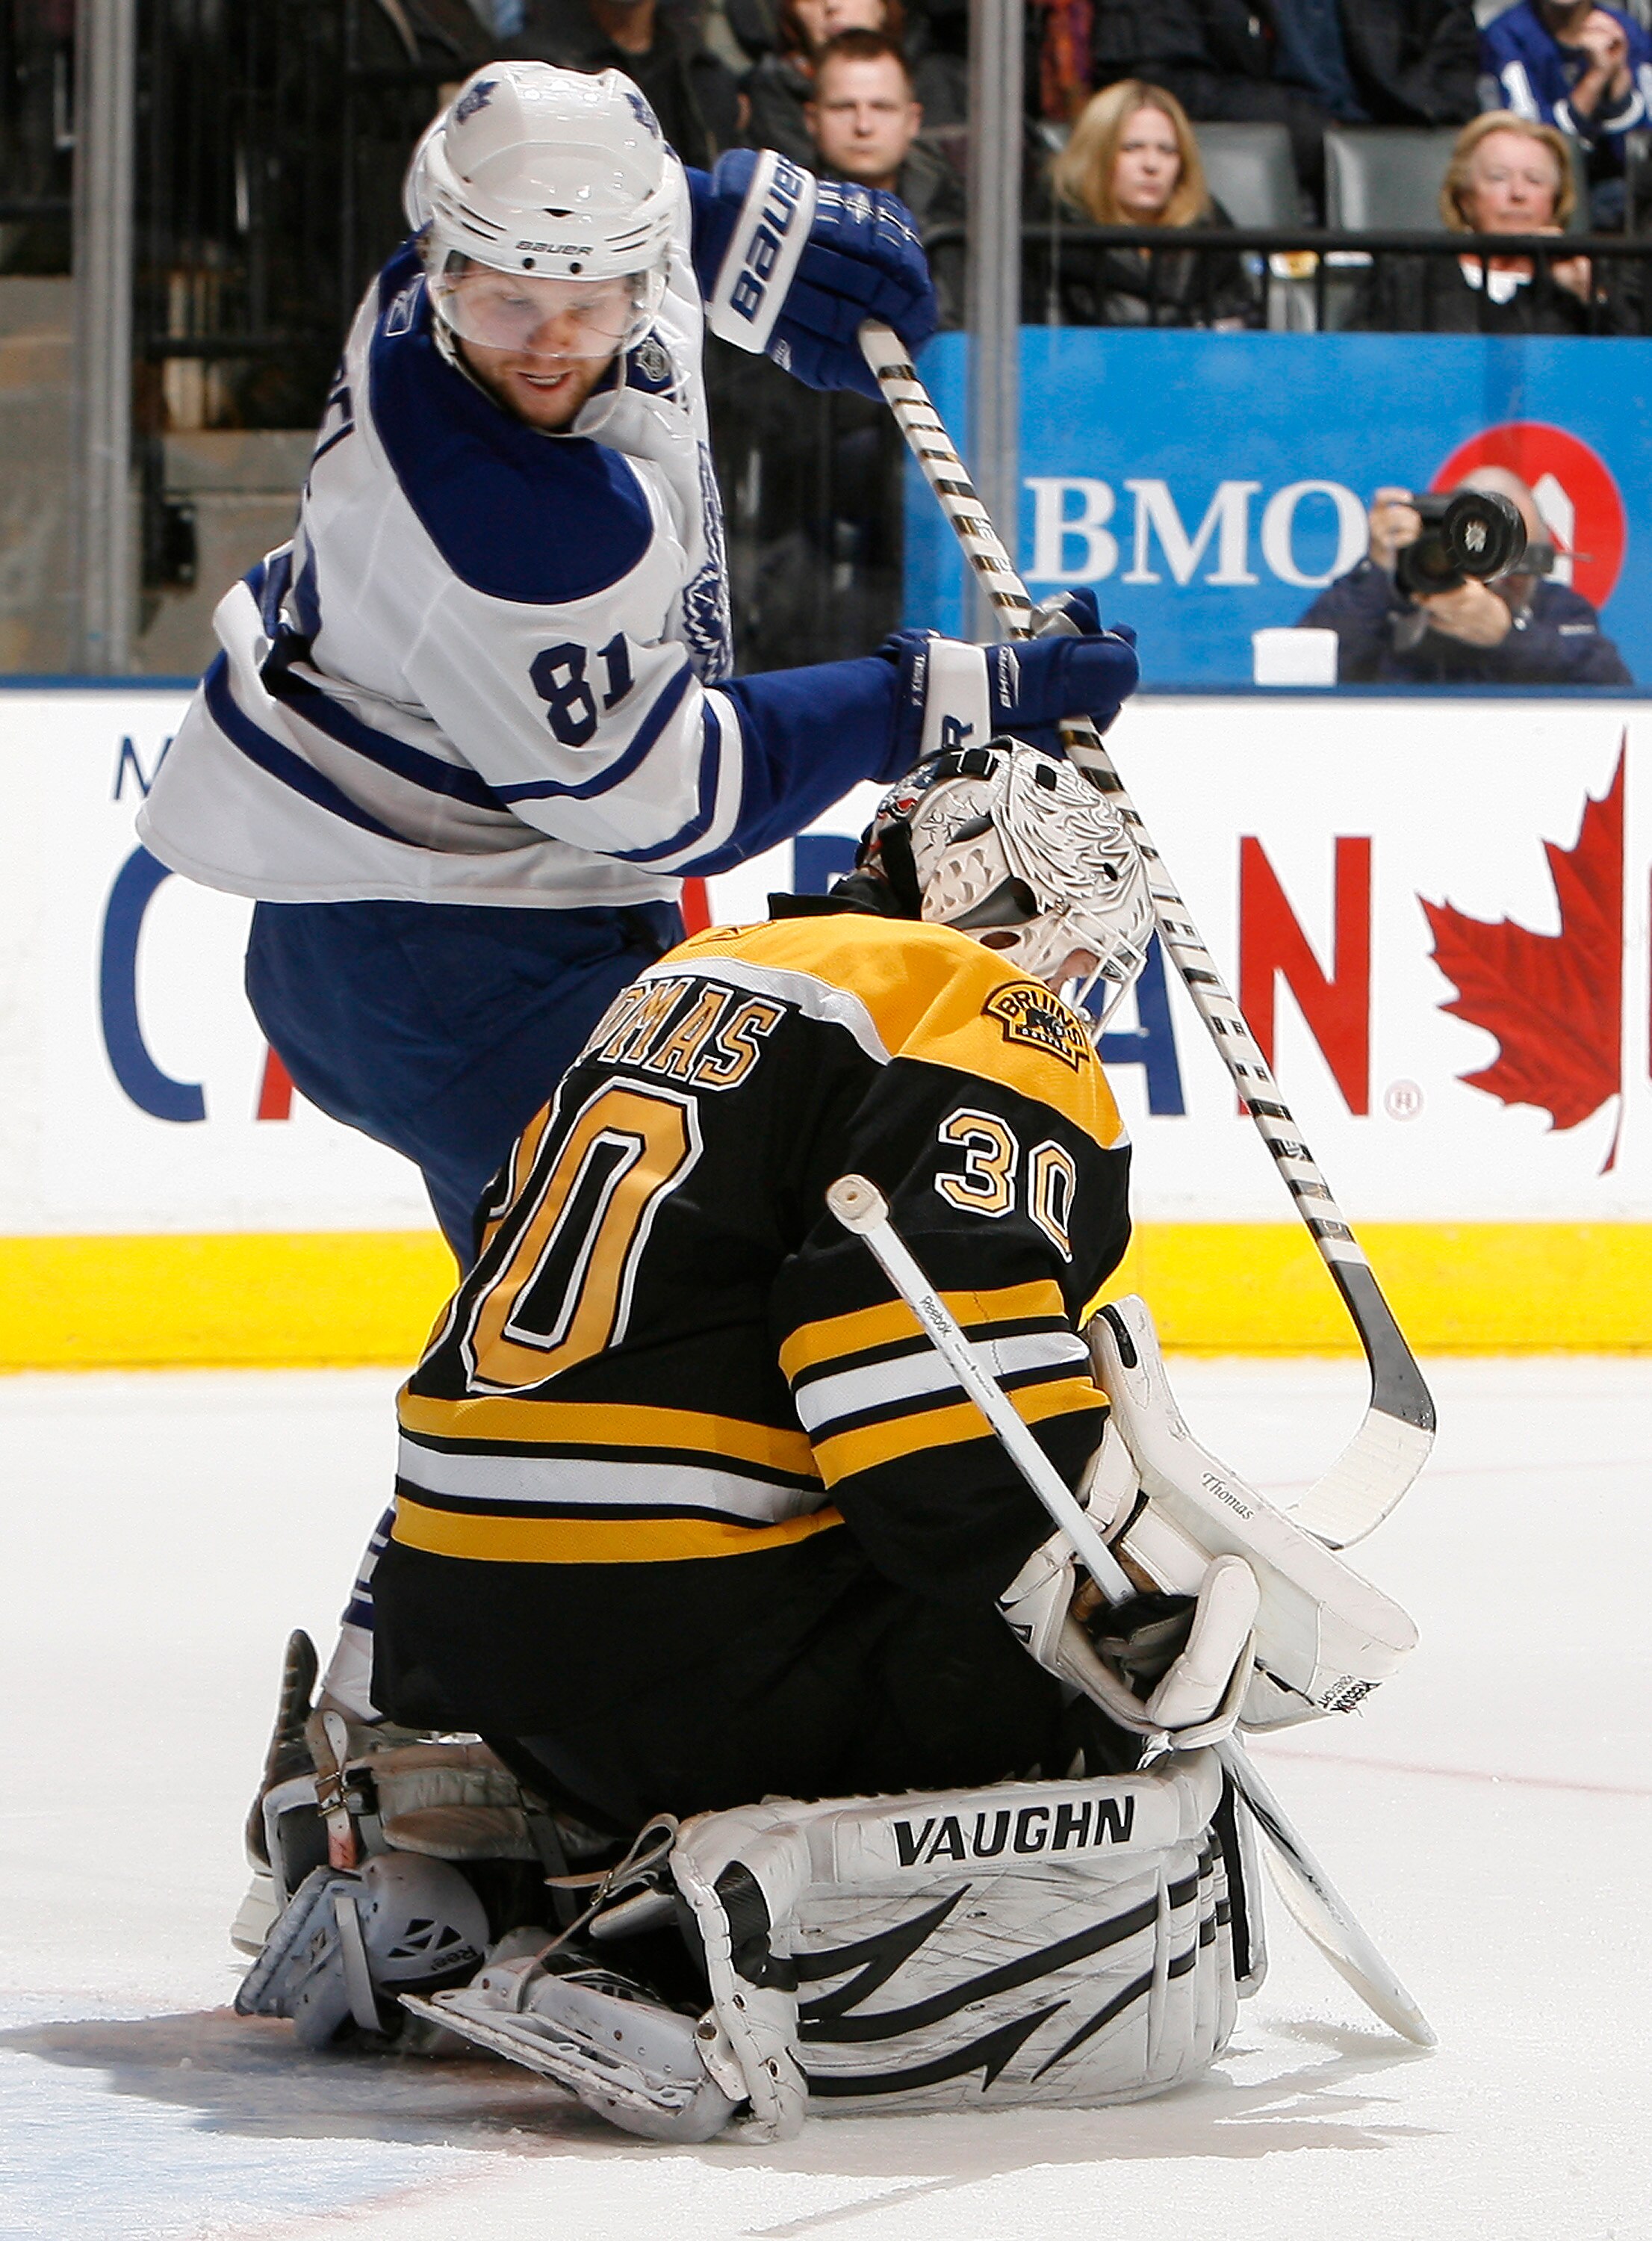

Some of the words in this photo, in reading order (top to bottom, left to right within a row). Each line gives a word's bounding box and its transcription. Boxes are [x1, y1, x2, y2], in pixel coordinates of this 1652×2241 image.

[515, 241, 594, 255] BAUER
[1022, 477, 1370, 588] BMO
[529, 631, 635, 748] 81
[995, 991, 1084, 1047] BRUINS
[934, 1107, 1077, 1264] 30
[919, 1295, 953, 1338] Reebok
[1202, 1472, 1255, 1519] Thomas
[893, 1796, 1134, 1868] VAUGHN
